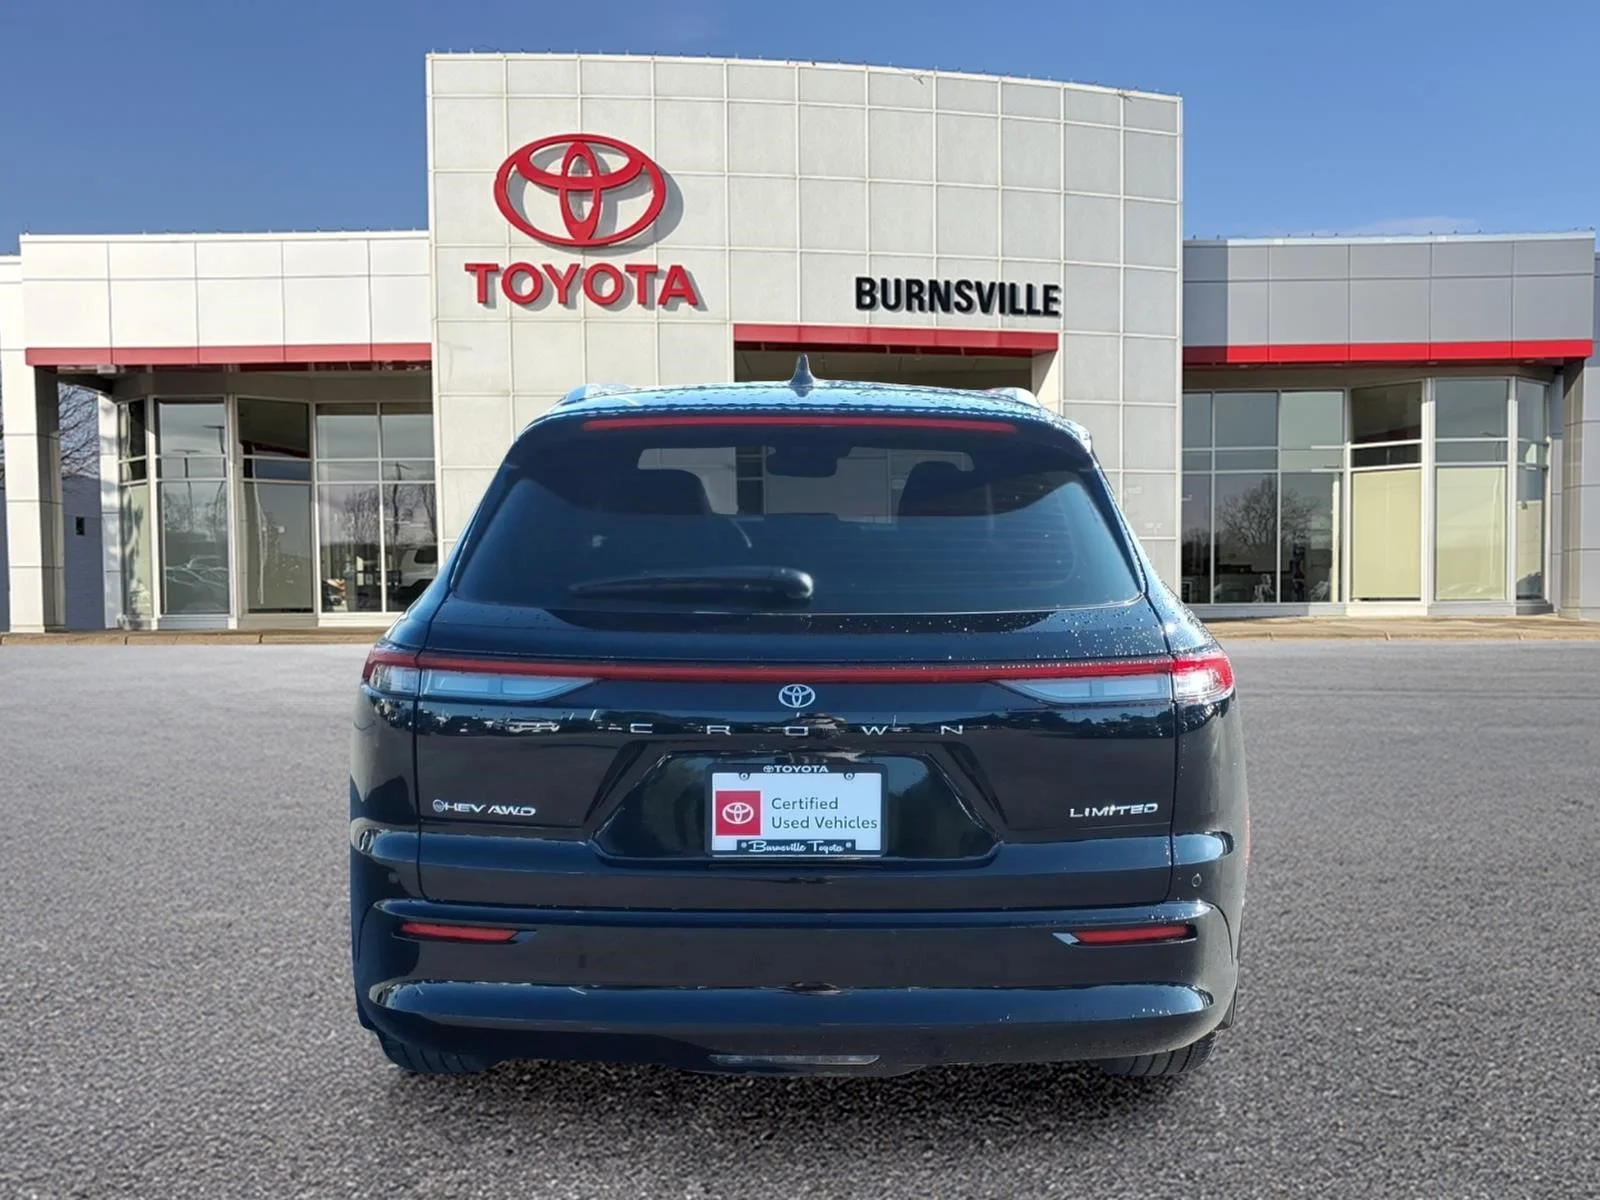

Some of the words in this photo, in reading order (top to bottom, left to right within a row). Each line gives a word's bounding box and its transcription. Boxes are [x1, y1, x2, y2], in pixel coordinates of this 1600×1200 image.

[464, 262, 699, 306] TOYOTA
[855, 276, 1061, 317] BURNSVILLE
[629, 723, 964, 736] CROWN
[775, 765, 829, 773] TOYOTA
[443, 802, 486, 813] HEV
[488, 804, 536, 816] AWD
[771, 797, 838, 810] Certified
[1069, 803, 1159, 818] LIMITED
[771, 816, 810, 829] Used
[815, 816, 878, 829] Vehicles
[748, 840, 806, 852] Burnsville
[808, 840, 844, 854] Toyota
